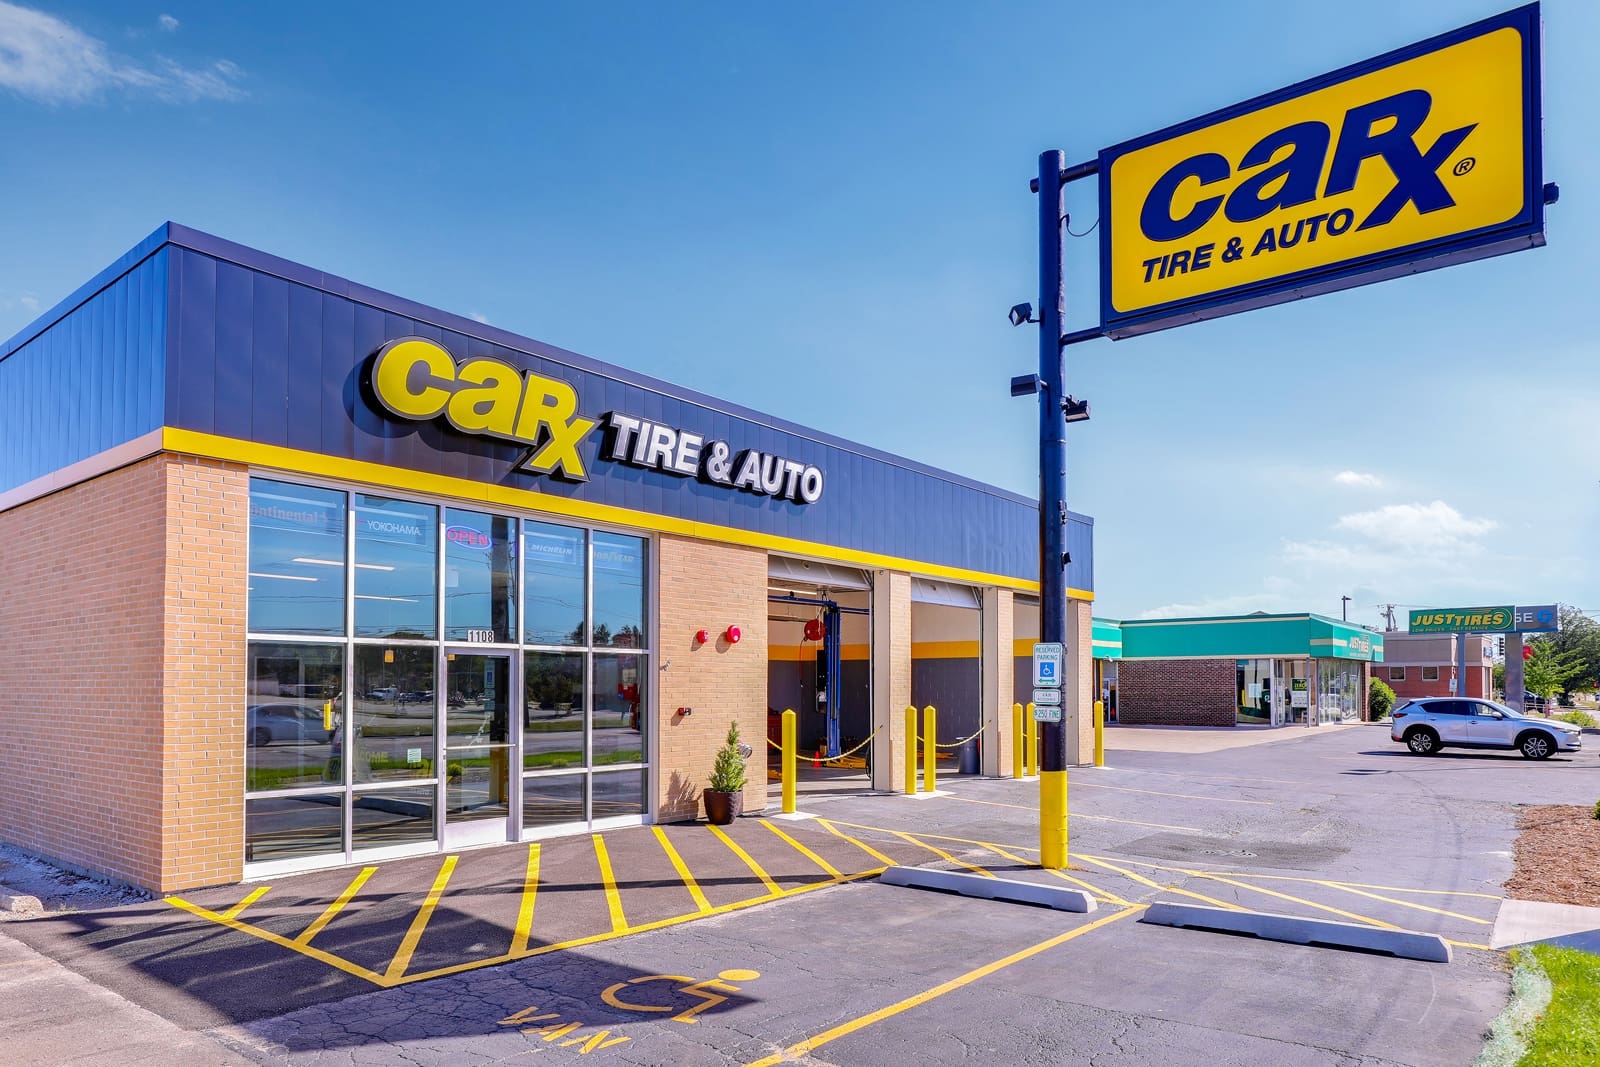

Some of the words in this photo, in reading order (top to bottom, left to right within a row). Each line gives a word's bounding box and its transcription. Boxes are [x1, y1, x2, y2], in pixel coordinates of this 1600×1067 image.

[1142, 242, 1216, 283] TIRE
[1221, 237, 1243, 263] &
[1251, 208, 1355, 256] AUTO
[610, 412, 704, 475] TIRE
[705, 439, 734, 484] &
[735, 450, 825, 505] AUTO
[367, 519, 422, 537] YOKOHAMA
[447, 528, 489, 547] OPEN
[531, 543, 573, 556] MICHELIN
[469, 630, 494, 643] 1108
